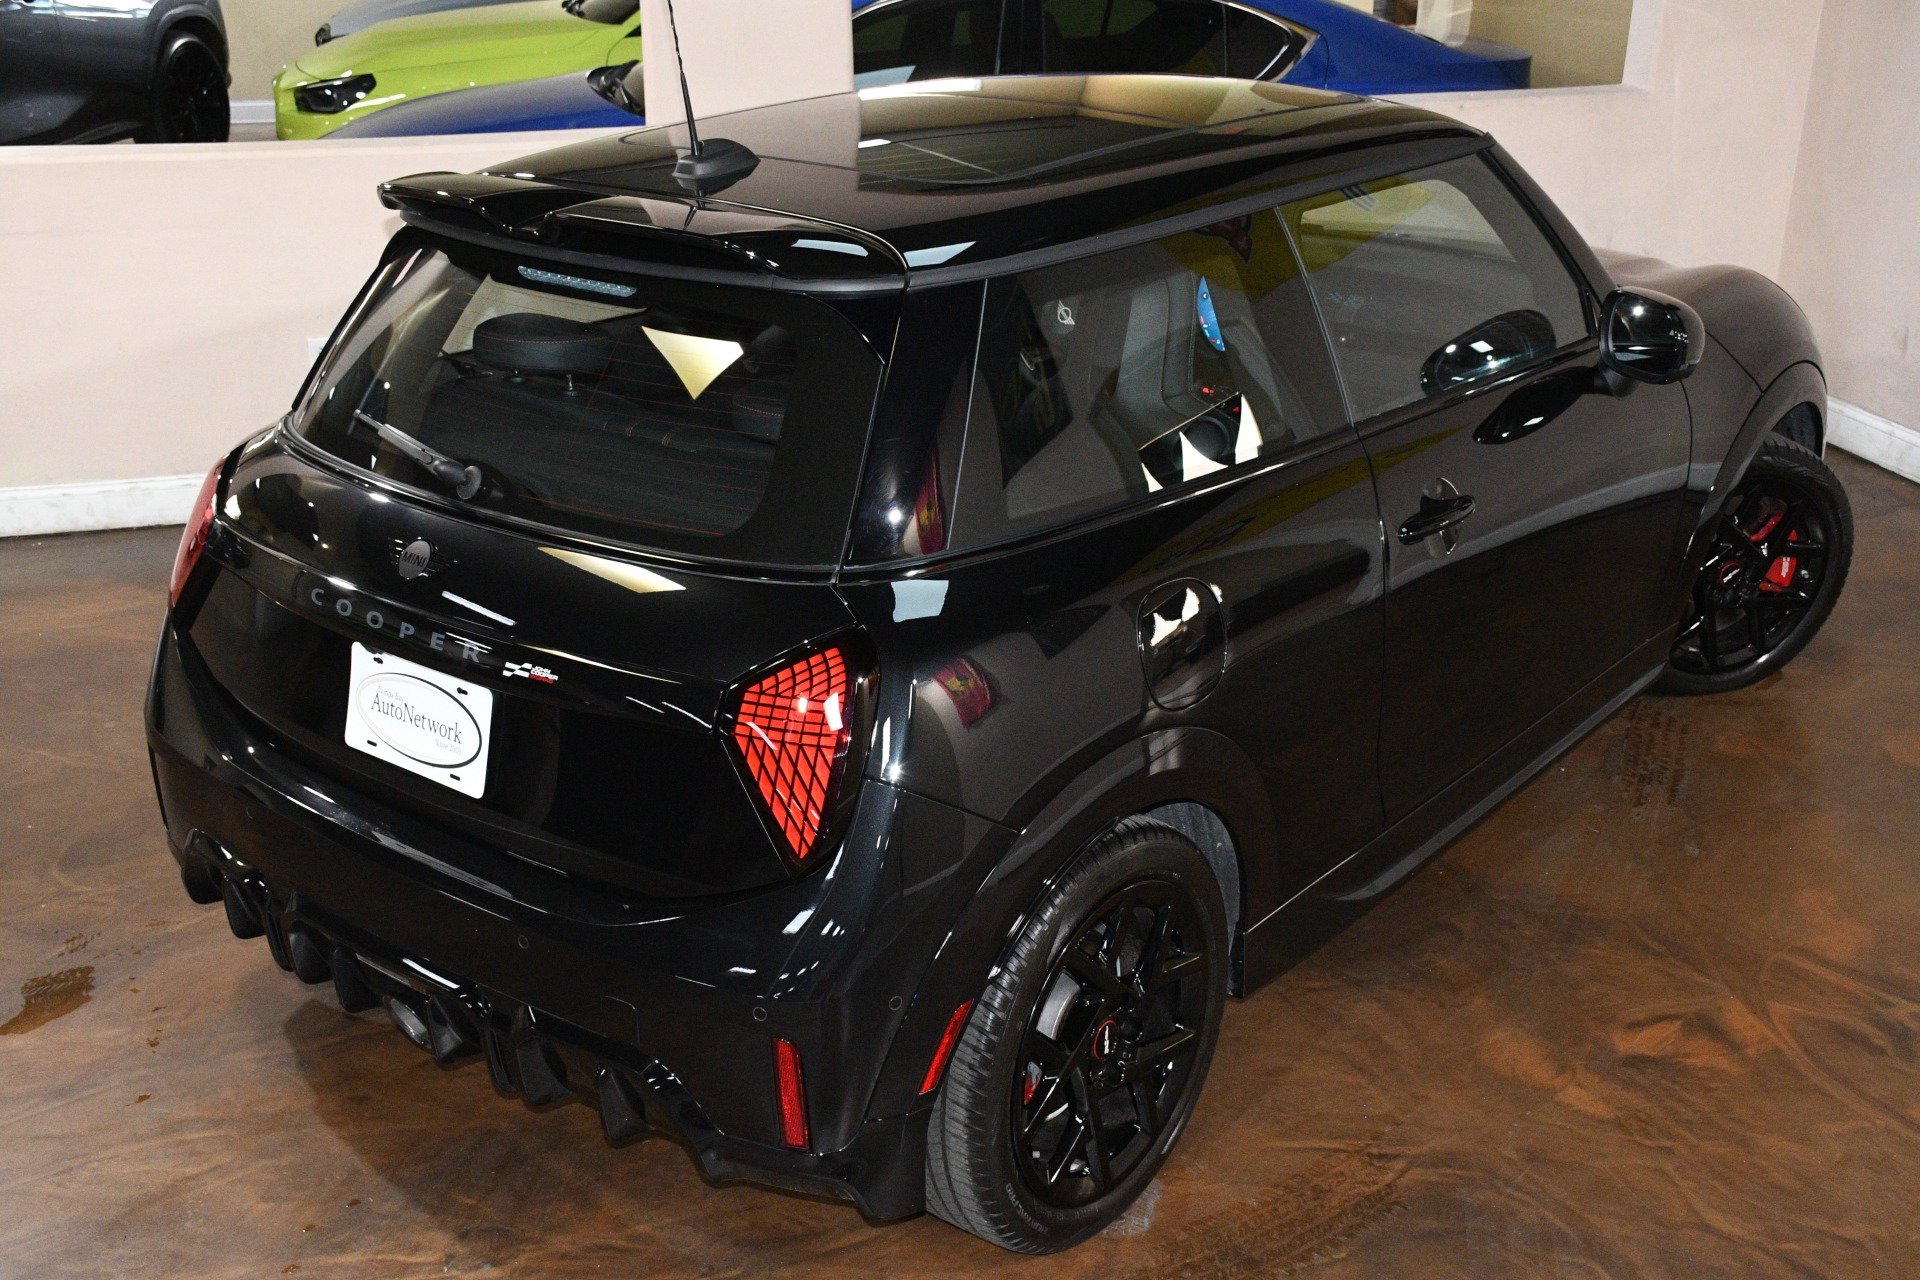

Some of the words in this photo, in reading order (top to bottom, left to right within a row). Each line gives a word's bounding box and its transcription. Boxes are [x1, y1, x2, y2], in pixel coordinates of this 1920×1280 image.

[401, 551, 428, 568] MINI
[311, 587, 481, 664] COOPER
[371, 692, 462, 745] AutoNetwork
